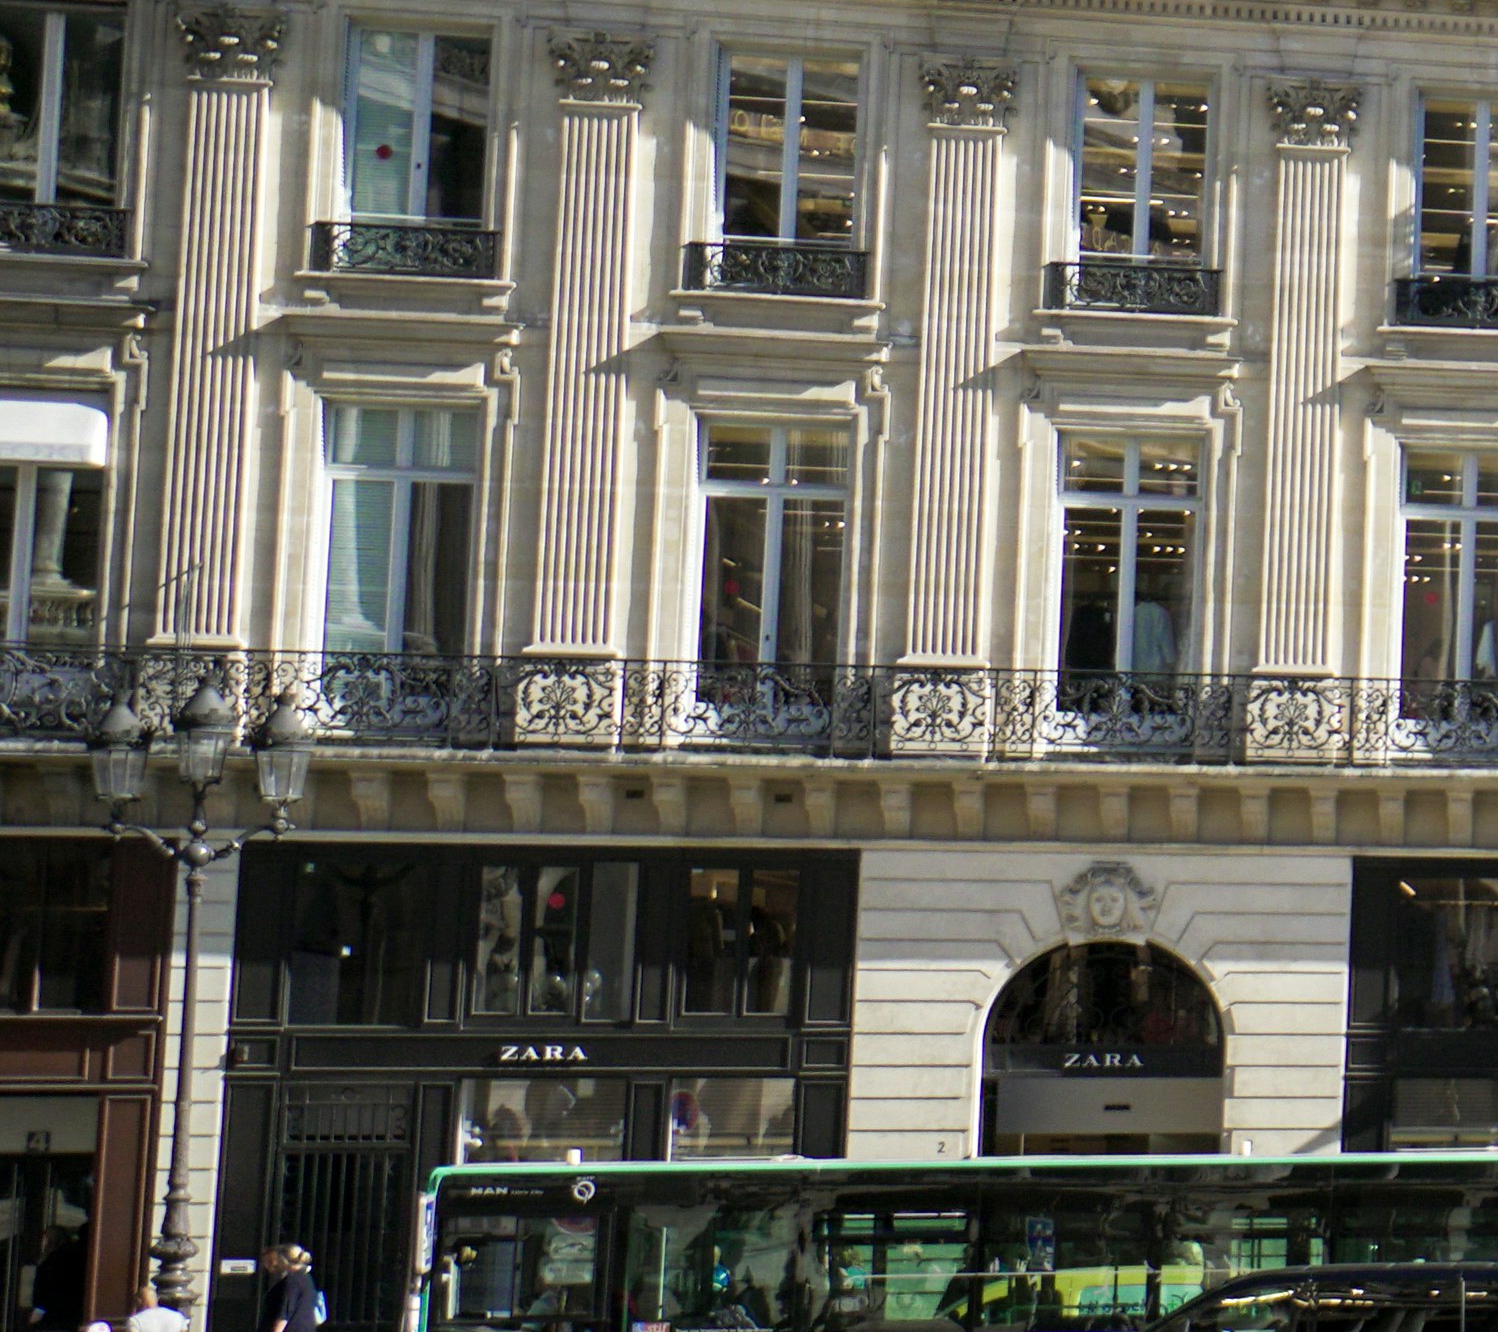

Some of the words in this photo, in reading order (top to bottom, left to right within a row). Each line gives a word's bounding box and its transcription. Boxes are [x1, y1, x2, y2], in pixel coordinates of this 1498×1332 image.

[500, 1045, 588, 1061] ZARA
[1063, 1052, 1145, 1068] ZARA
[937, 1141, 946, 1154] 2
[470, 1187, 509, 1196] MAN
